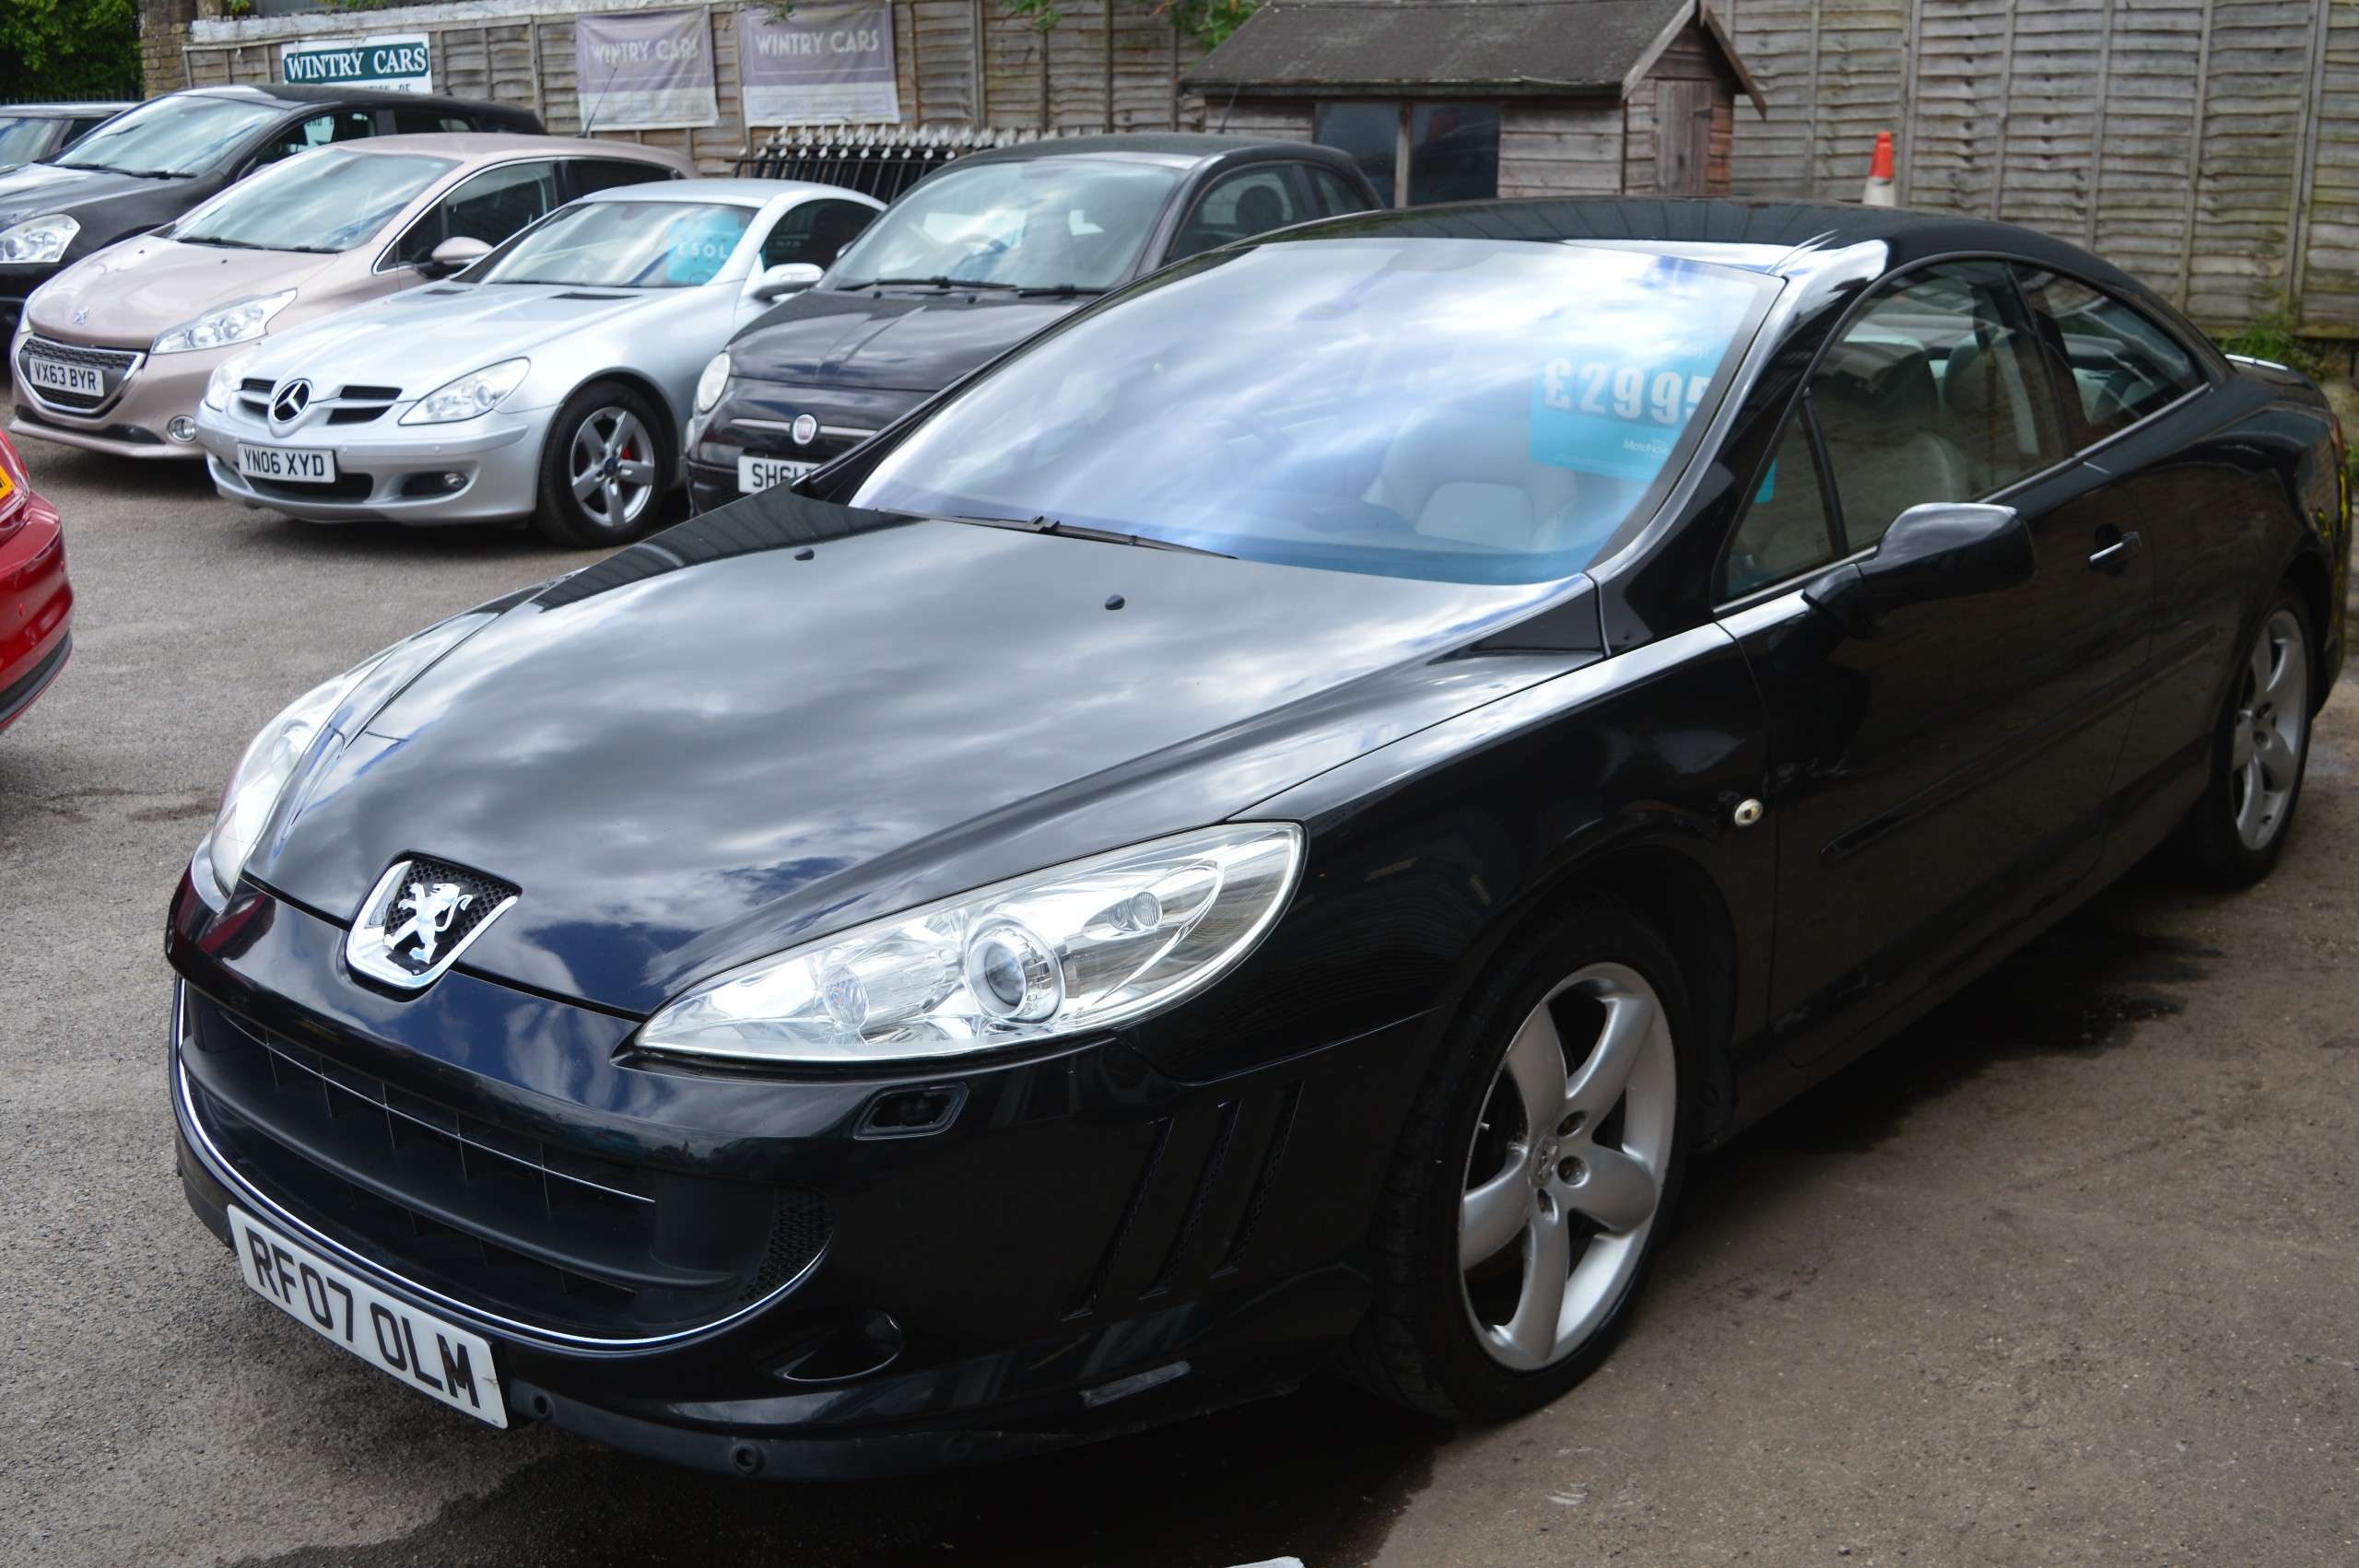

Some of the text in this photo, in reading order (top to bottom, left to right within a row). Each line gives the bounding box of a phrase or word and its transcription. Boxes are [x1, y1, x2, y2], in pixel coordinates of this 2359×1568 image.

[655, 36, 699, 60] CARS
[756, 29, 879, 55] WINTRY CARS
[286, 47, 427, 79] WINTRY CARS
[34, 362, 96, 391] VX63 BYR
[244, 447, 324, 476] YN06 XYD
[245, 1226, 481, 1409] RF07 OLM
